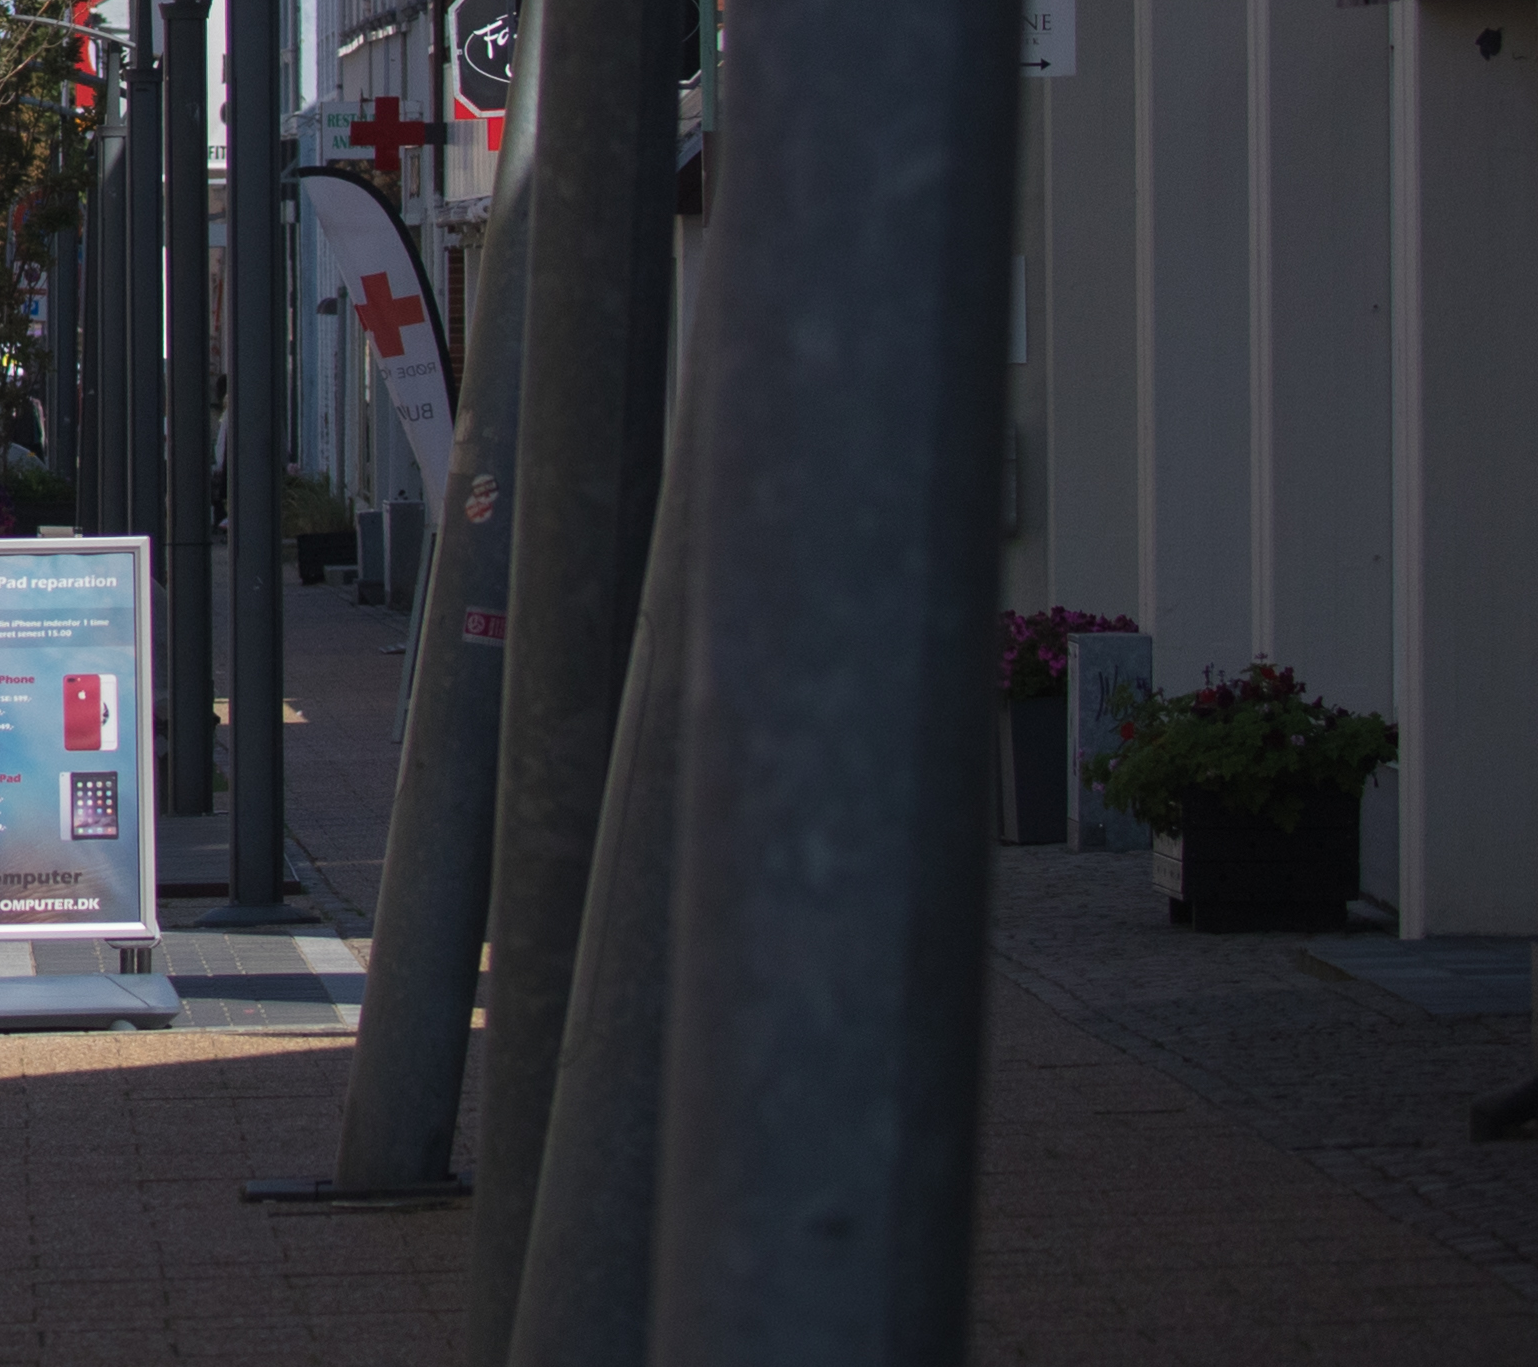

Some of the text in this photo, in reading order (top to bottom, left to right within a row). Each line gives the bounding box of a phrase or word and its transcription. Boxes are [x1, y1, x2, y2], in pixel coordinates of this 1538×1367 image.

[30, 574, 117, 591] reparation
[11, 619, 42, 628] iPhone
[90, 618, 110, 627] time
